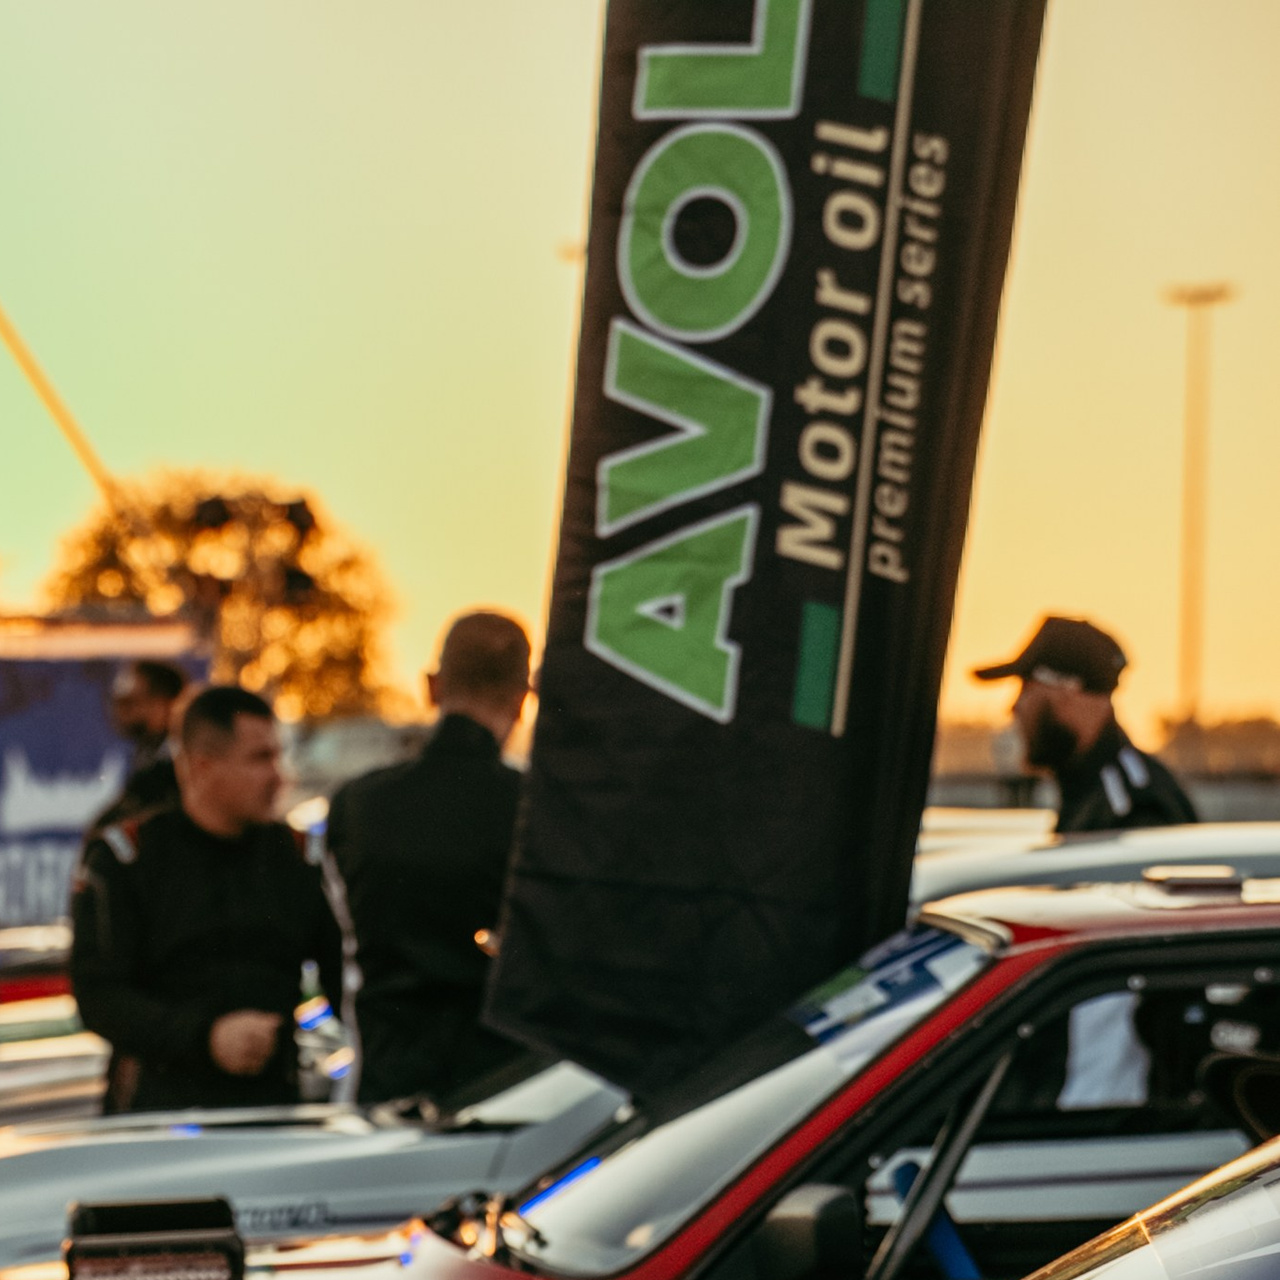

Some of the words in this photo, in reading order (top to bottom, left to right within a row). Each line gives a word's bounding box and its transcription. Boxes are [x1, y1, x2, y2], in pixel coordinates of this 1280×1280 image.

[810, 120, 889, 251] oil
[897, 133, 950, 308] series
[775, 268, 872, 571] Motor
[868, 320, 927, 584] premium
